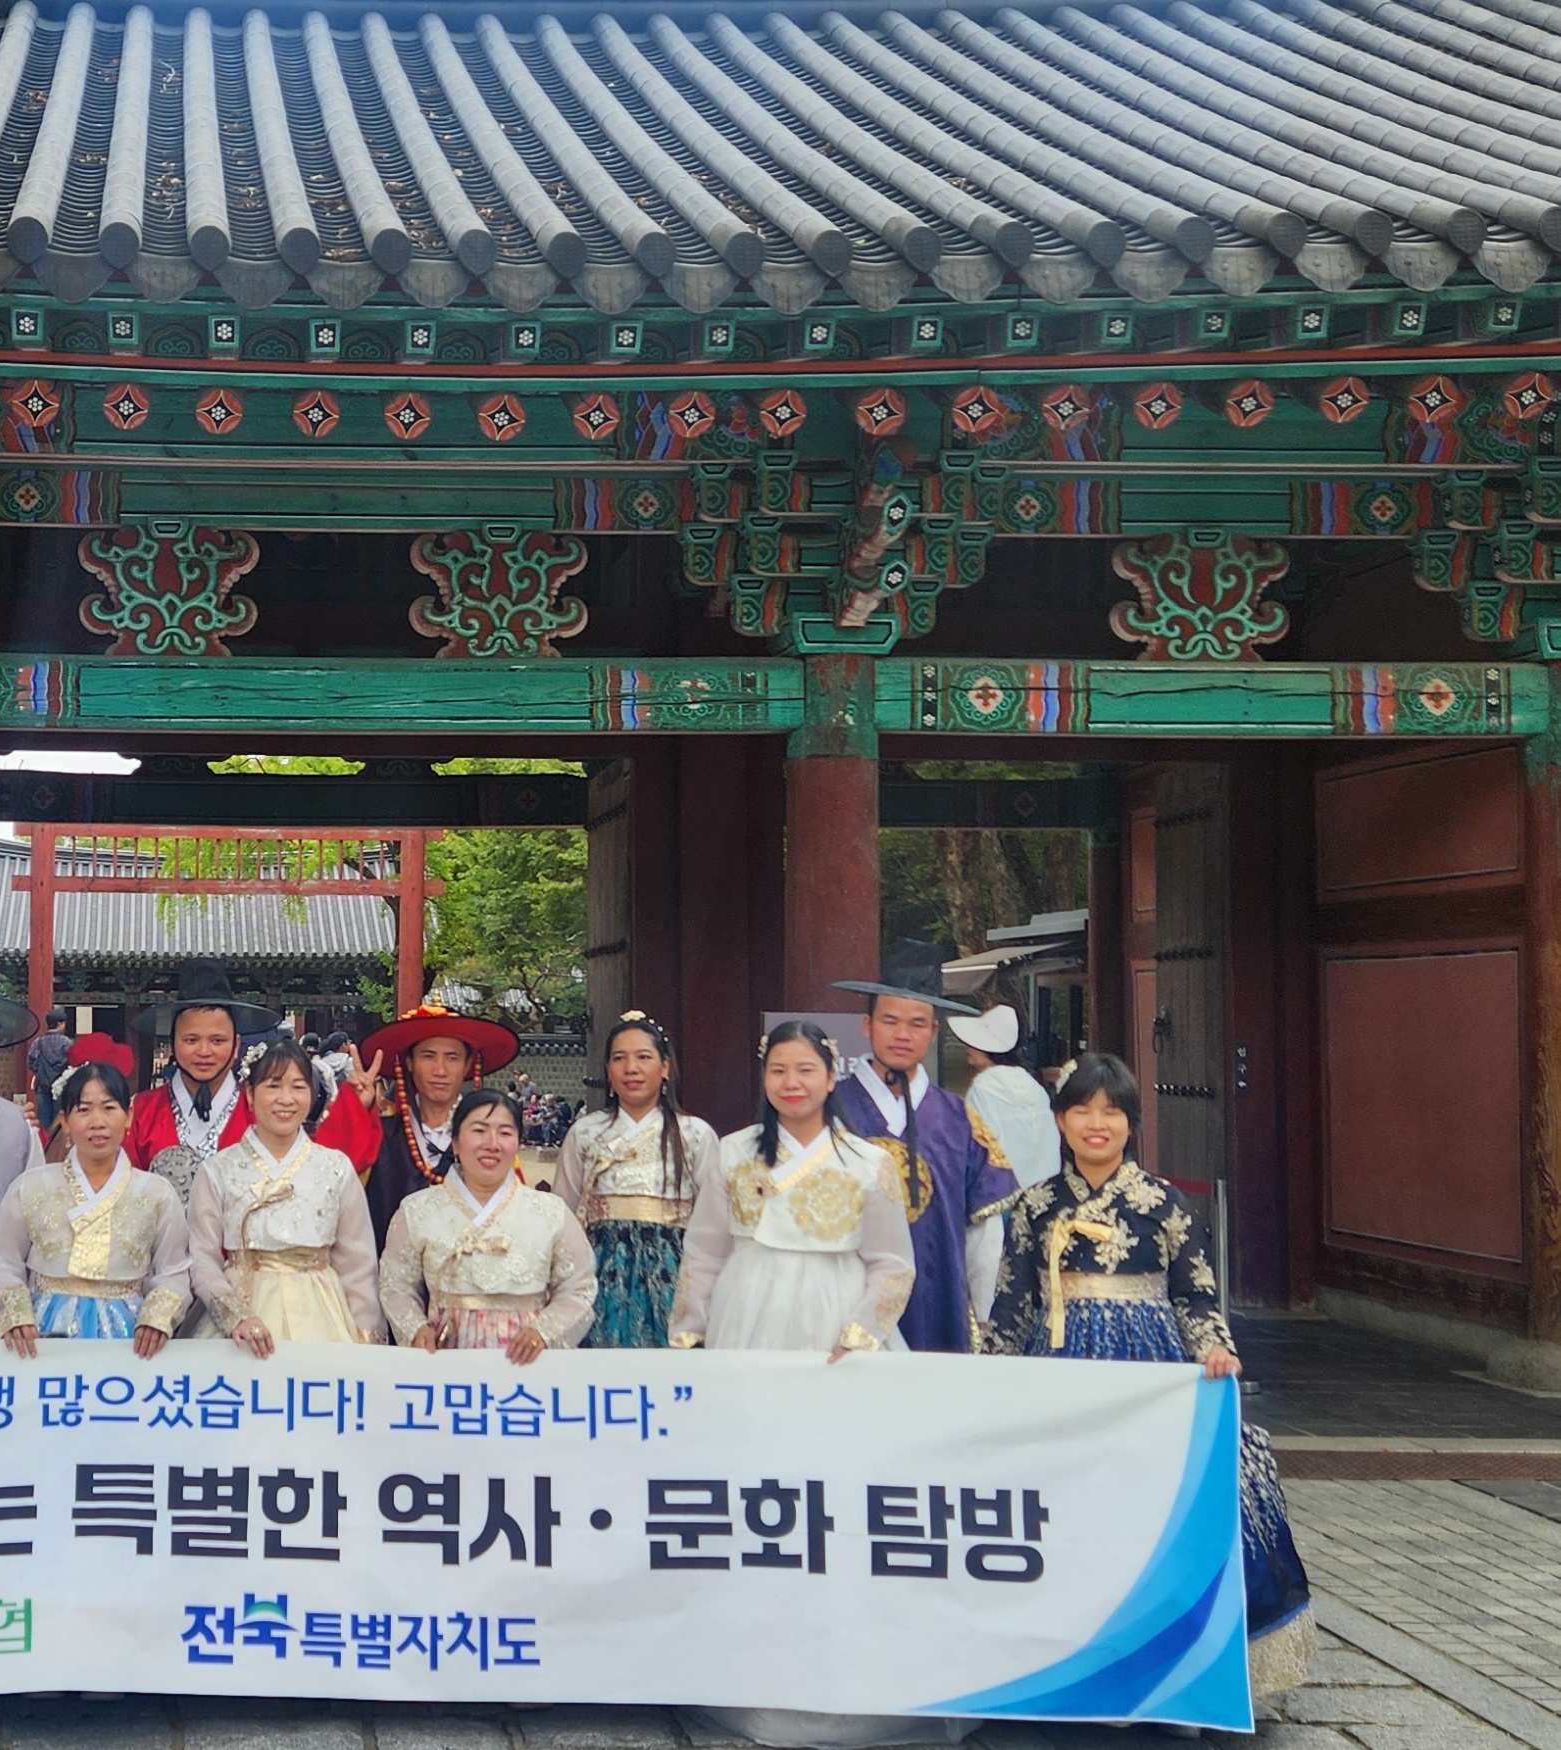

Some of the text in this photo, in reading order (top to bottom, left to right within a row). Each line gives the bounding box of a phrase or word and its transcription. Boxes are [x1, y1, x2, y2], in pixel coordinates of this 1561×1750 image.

[37, 1374, 366, 1435] 많으셨습니다!
[71, 1463, 348, 1562] 특별한
[866, 1484, 1050, 1583] 탐방
